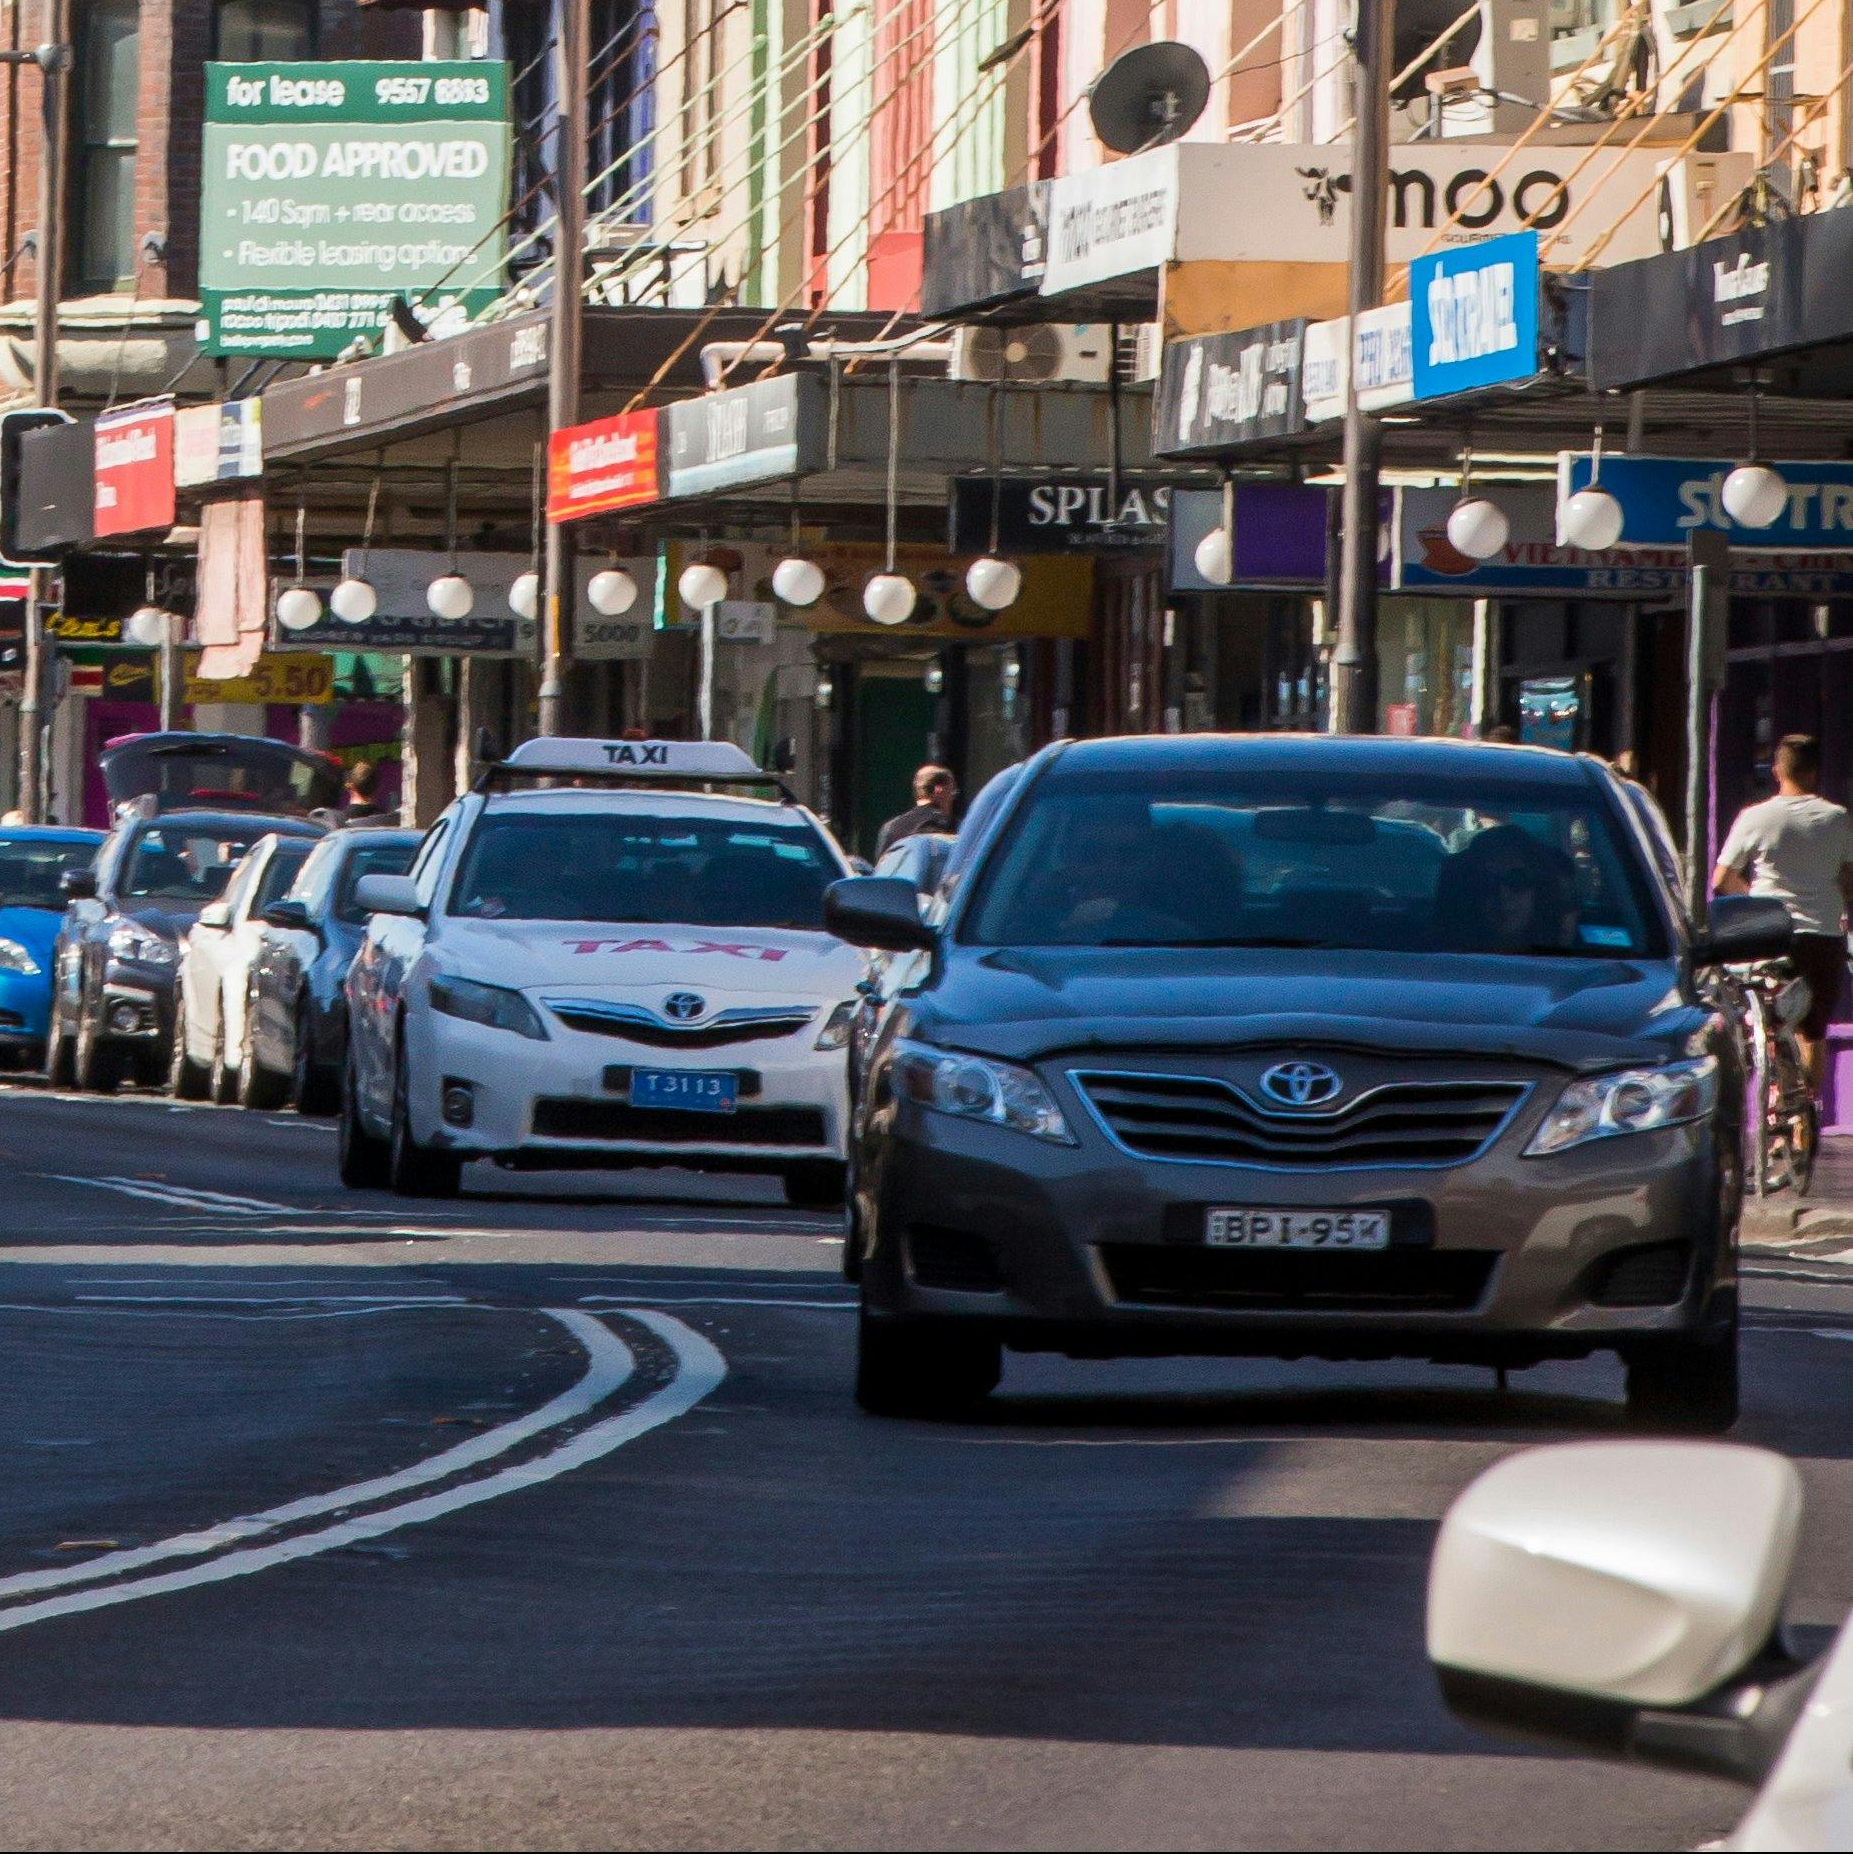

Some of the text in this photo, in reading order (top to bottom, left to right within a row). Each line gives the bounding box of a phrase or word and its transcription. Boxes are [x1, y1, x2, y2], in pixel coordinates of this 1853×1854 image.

[227, 76, 265, 105] for
[270, 75, 345, 106] lease
[226, 141, 489, 180] FOOD APPROVED
[603, 744, 669, 765] TAXI
[562, 939, 789, 962] TAXI
